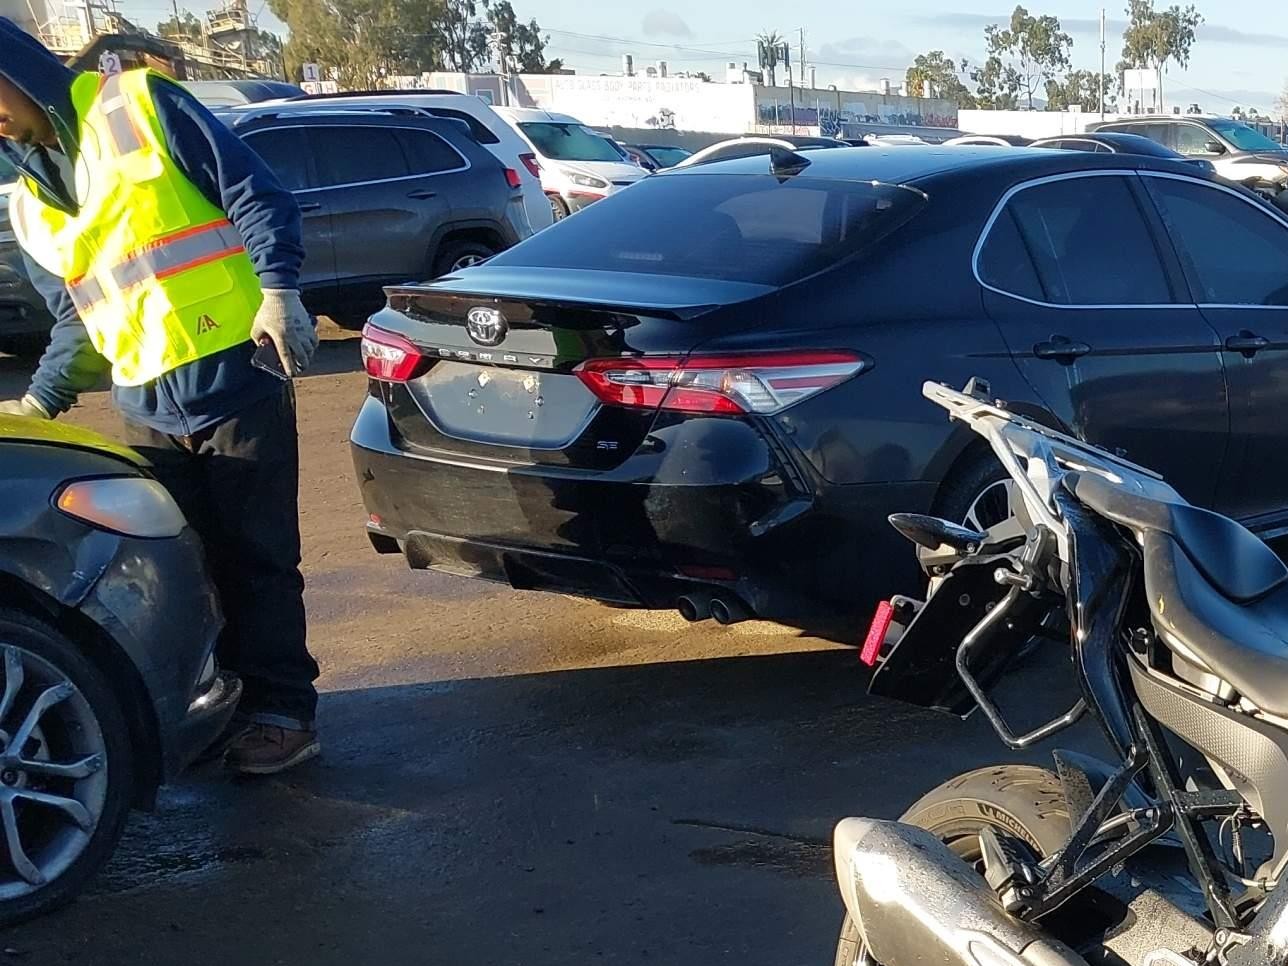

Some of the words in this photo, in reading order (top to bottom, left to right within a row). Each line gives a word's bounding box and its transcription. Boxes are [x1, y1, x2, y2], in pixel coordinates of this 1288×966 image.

[106, 57, 118, 73] 2
[307, 66, 317, 80] 1
[597, 441, 619, 450] SE
